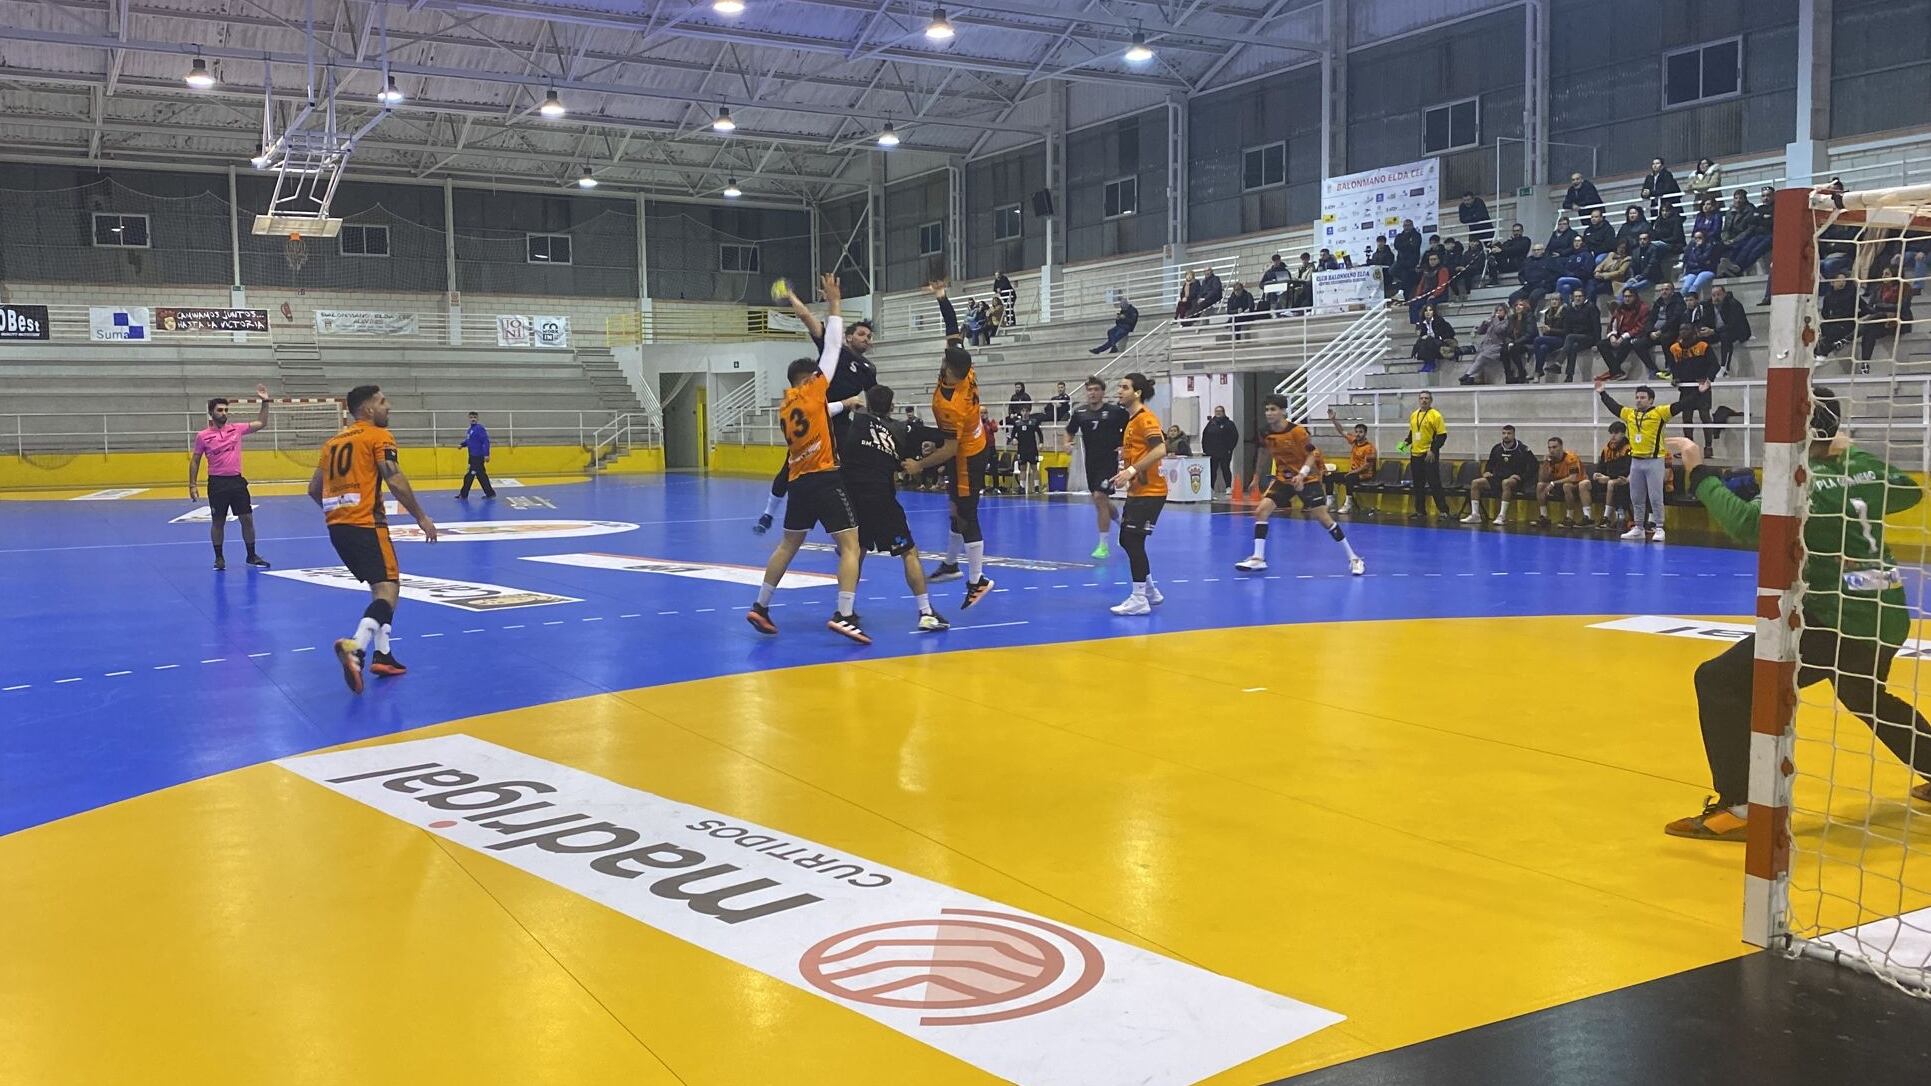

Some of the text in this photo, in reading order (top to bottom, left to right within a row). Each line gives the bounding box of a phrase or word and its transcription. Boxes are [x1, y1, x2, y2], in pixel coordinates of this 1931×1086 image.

[1336, 175, 1386, 191] BALONMANO
[1388, 171, 1409, 181] ELDA
[96, 329, 129, 339] Suma
[207, 320, 218, 329] LA
[329, 442, 353, 480] 10
[324, 763, 824, 925] madrigal
[686, 819, 891, 888] CURTIDOS
